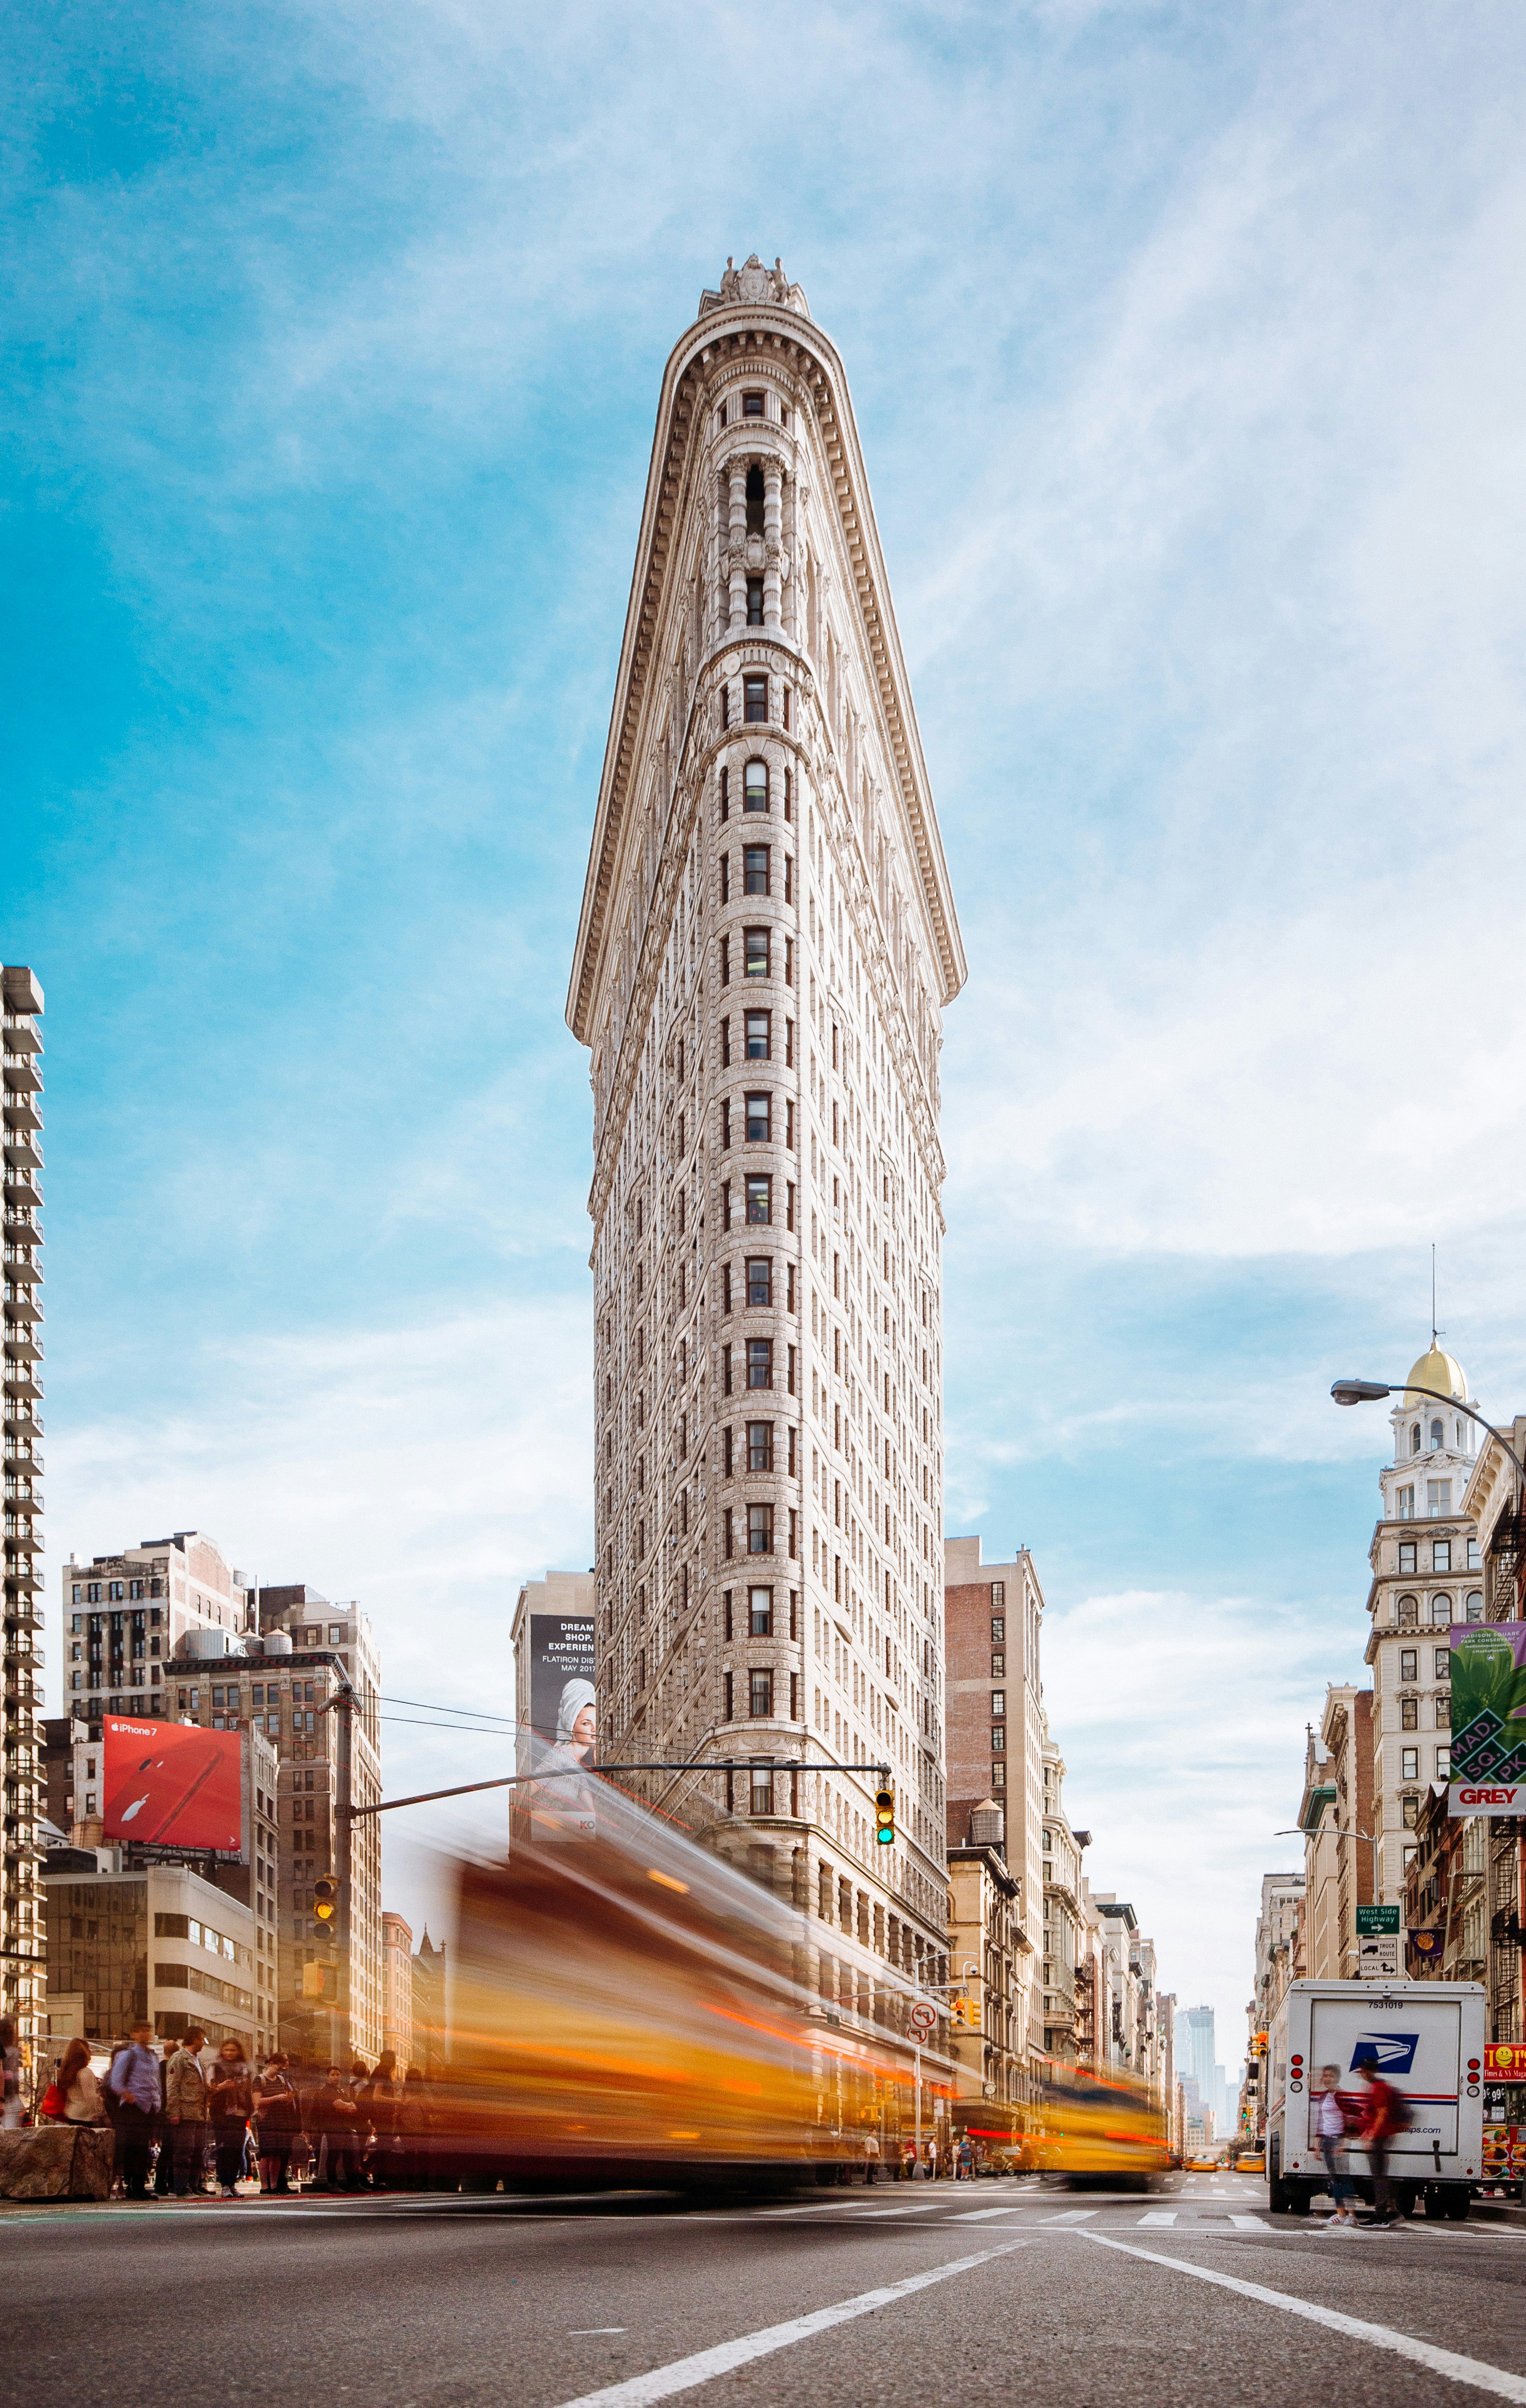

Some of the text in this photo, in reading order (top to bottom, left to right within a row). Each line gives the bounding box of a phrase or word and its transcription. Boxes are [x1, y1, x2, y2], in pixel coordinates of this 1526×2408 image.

[560, 1623, 594, 1632] DREAM
[565, 1633, 592, 1642] SHOP.
[548, 1642, 594, 1652] EXPERIEN
[542, 1656, 579, 1664] FLATIRON
[119, 1724, 157, 1736] iPhone 7
[1450, 1722, 1497, 1761] MAD.
[1467, 1752, 1501, 1778] SQ.
[1459, 1788, 1518, 1804] GREY
[1361, 1915, 1395, 1923] Highway
[1368, 2001, 1403, 2009] 7531019
[1499, 2069, 1503, 2078] &
